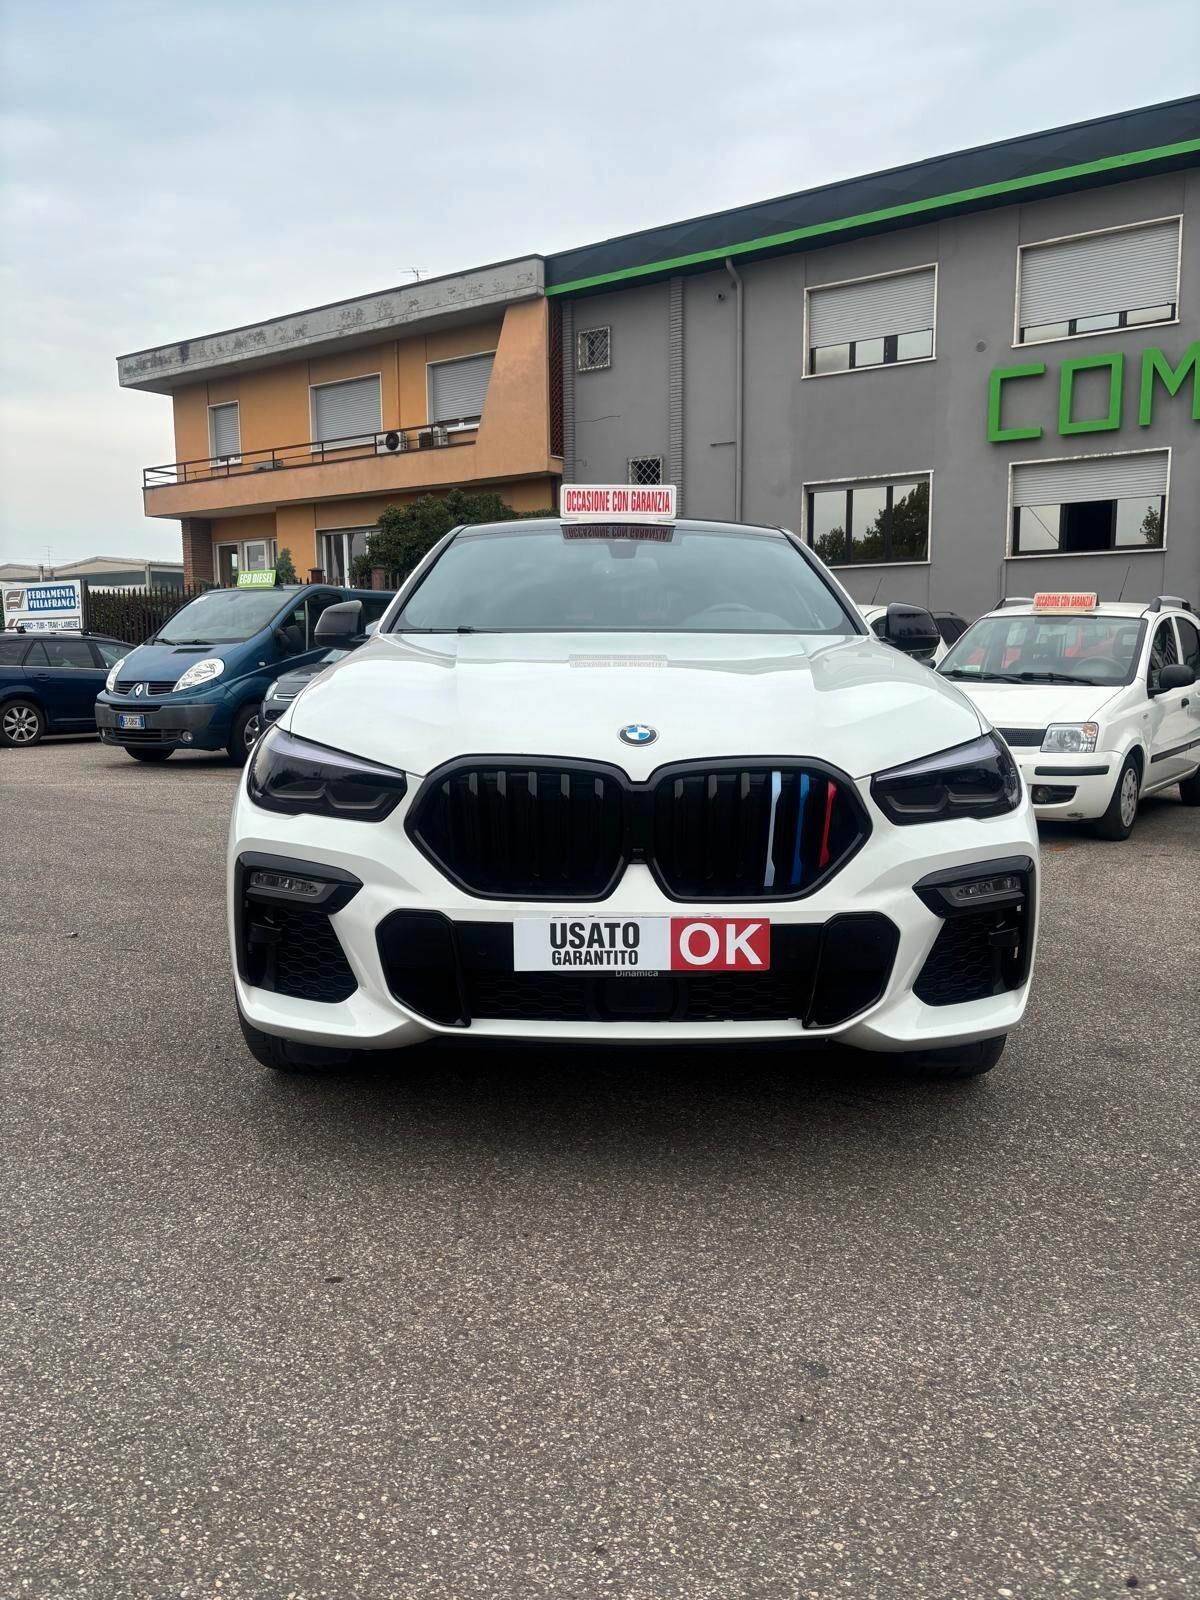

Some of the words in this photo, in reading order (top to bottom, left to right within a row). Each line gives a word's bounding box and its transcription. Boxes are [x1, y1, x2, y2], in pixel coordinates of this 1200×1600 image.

[988, 341, 1200, 442] COM
[566, 490, 610, 512] OCCASIONE
[612, 490, 629, 512] CON
[631, 491, 670, 512] GARANZIA
[240, 573, 251, 584] ECO
[252, 572, 273, 584] DIESEL
[28, 588, 74, 600] FERRAMENTA
[29, 598, 75, 609] VILLAFRANCA
[550, 921, 640, 950] USATO
[679, 922, 764, 966] OK
[551, 949, 639, 966] GARANTITO
